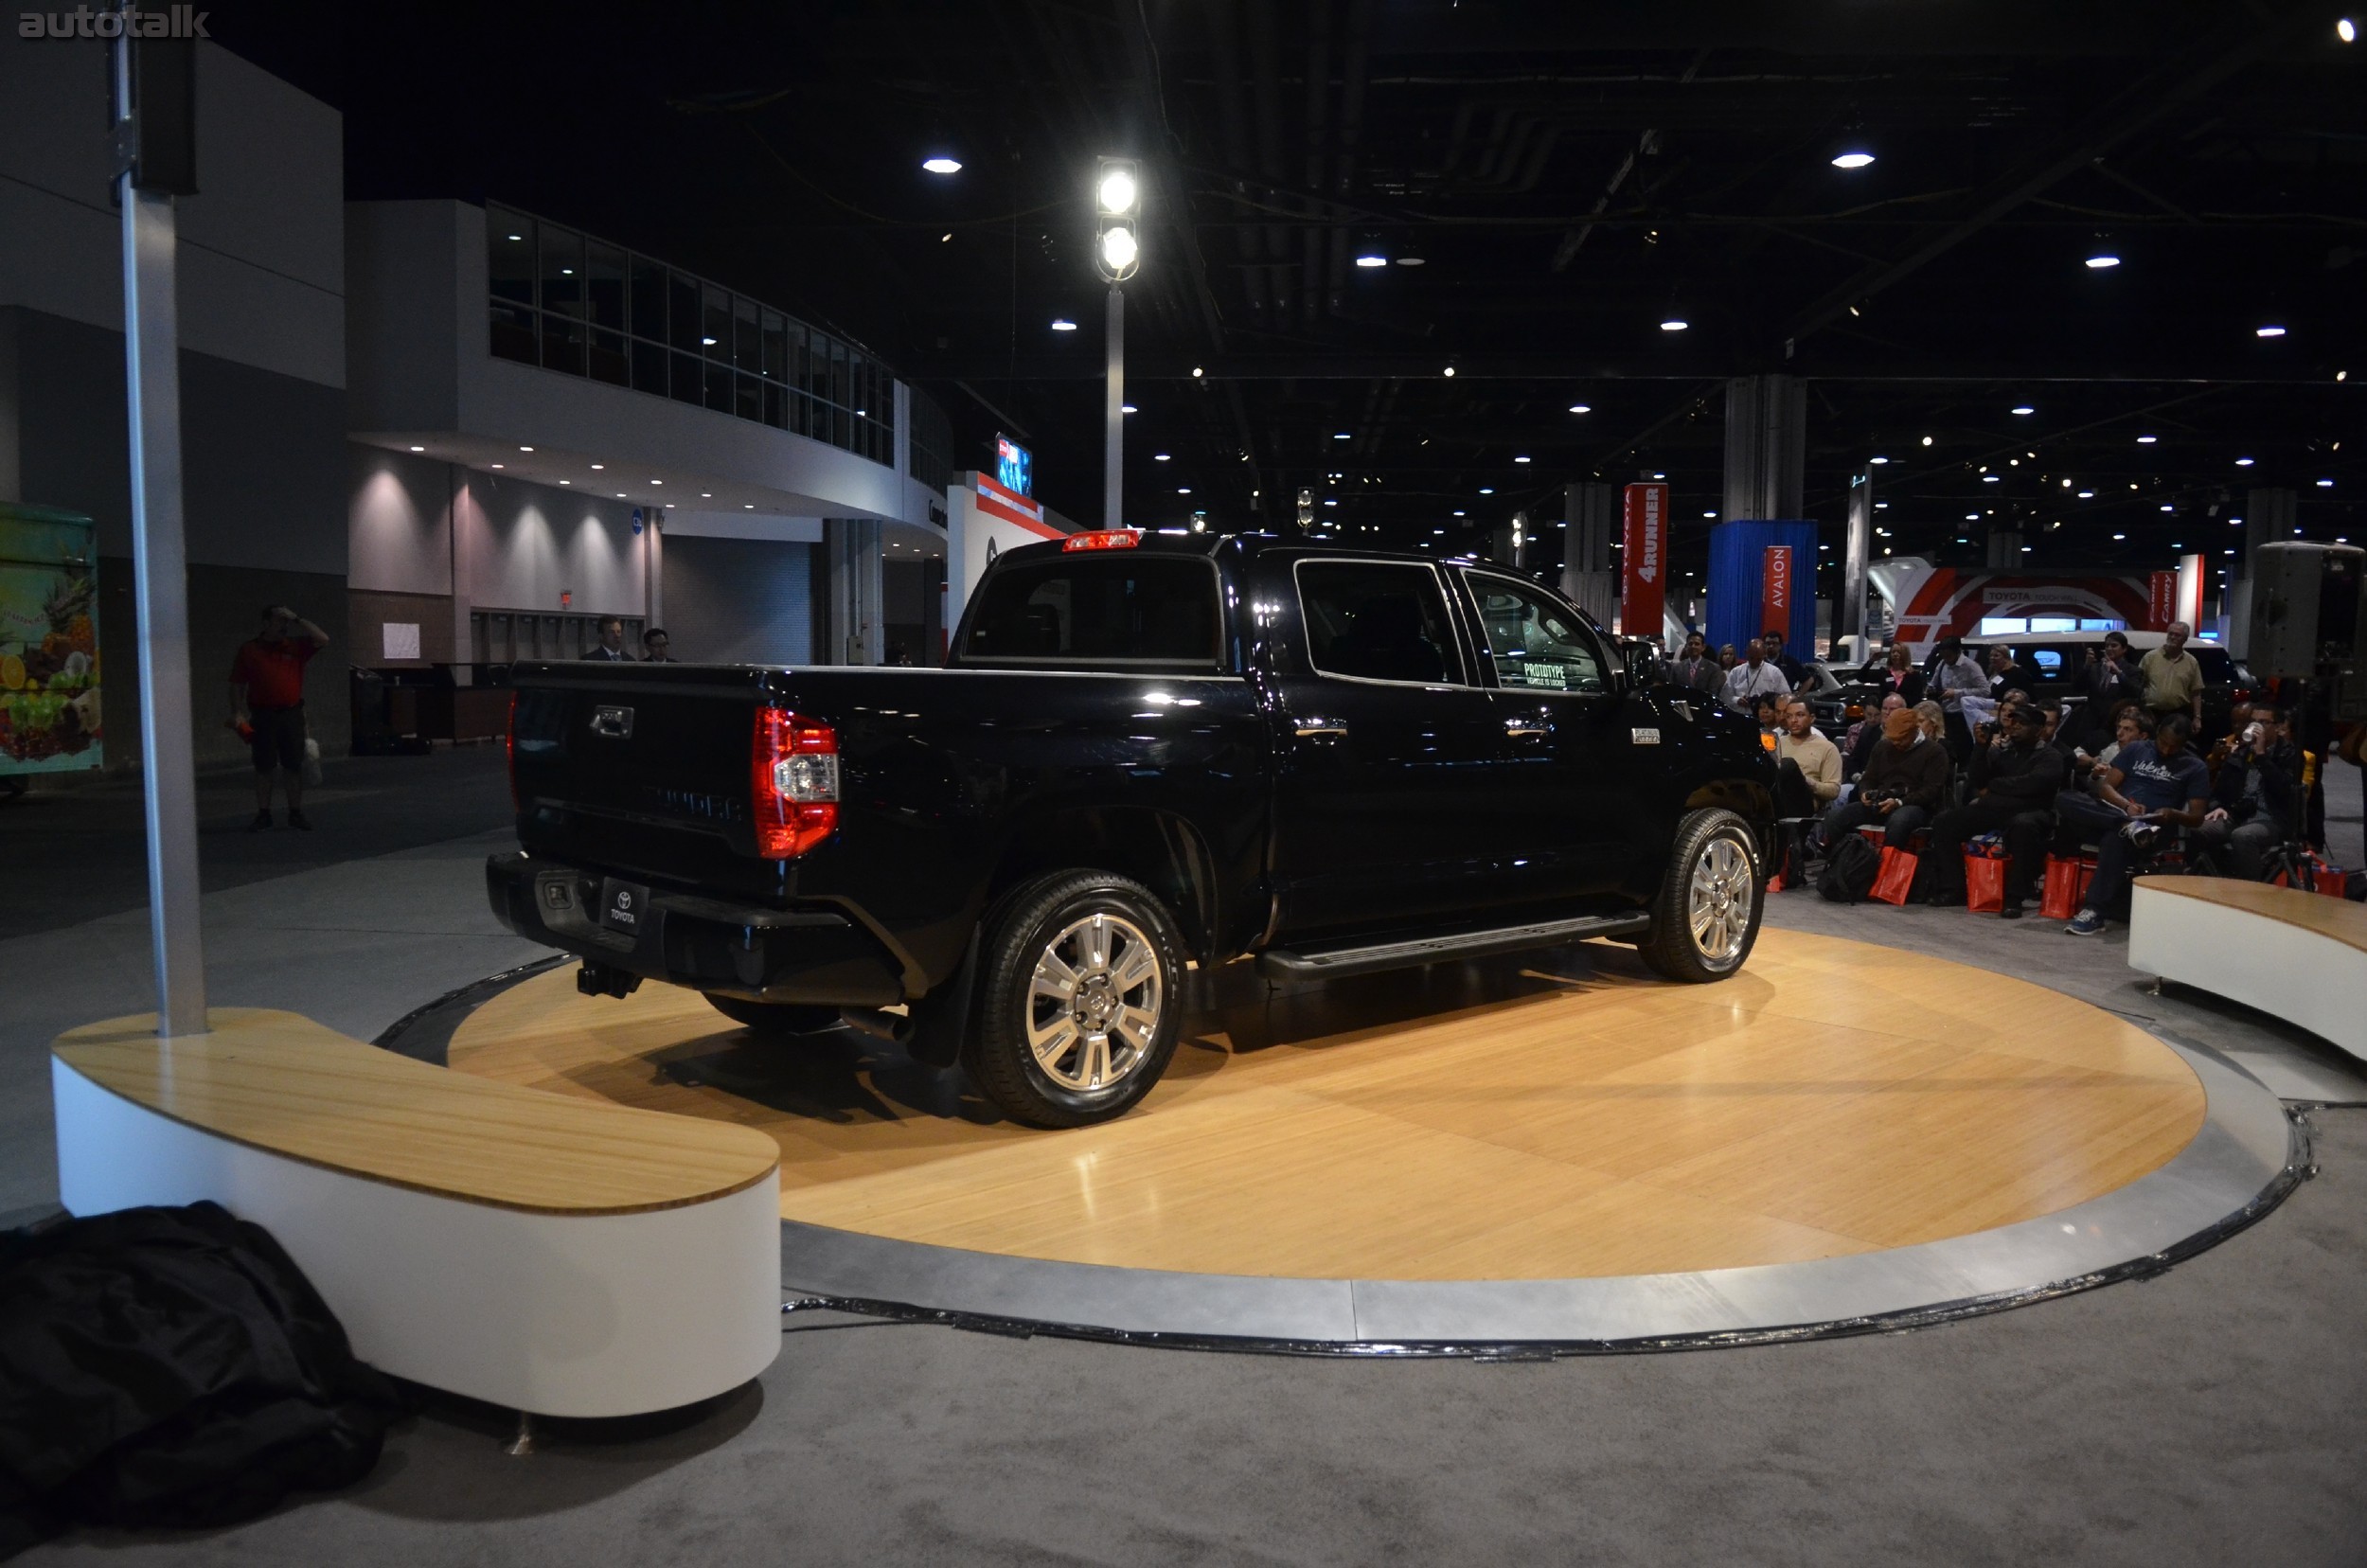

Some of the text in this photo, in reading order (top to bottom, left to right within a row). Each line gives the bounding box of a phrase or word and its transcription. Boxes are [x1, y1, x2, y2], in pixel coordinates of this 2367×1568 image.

[1638, 488, 1659, 583] 4RUNNER
[1772, 550, 1785, 608] AVALON
[1988, 592, 2031, 600] TOYOTA
[2162, 574, 2172, 624] CAMRY
[1524, 663, 1565, 679] PROTOTYPE
[611, 908, 635, 924] TOYOTA
